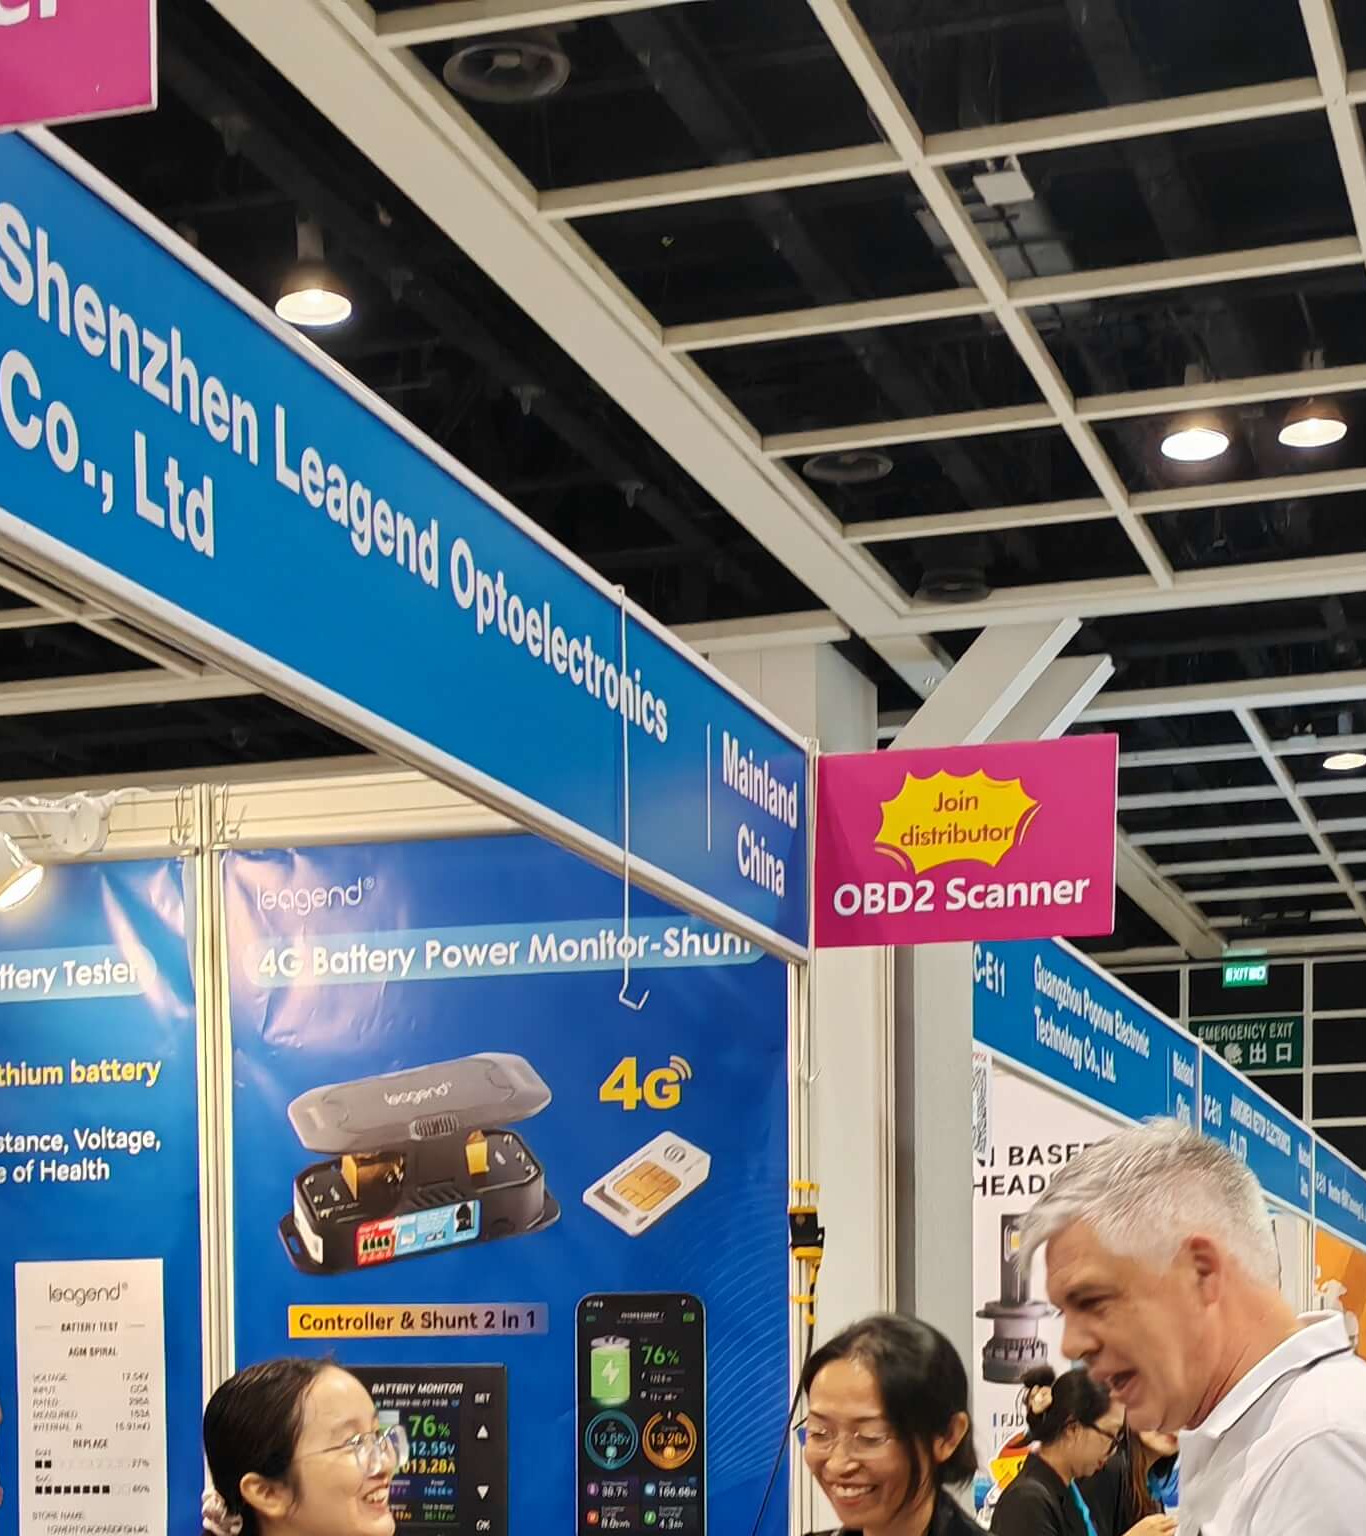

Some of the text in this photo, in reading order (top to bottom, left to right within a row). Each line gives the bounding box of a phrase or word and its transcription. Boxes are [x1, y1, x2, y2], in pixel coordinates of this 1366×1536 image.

[134, 431, 215, 558] Ltd
[275, 406, 439, 588] Leagend
[451, 538, 669, 744] Optoelectronics
[722, 731, 798, 829] Mainland
[934, 790, 979, 813] Join
[900, 823, 1013, 847] distributor
[737, 825, 785, 897] China
[833, 876, 1090, 917] OBD2 Scanner
[258, 950, 303, 980] 4G
[312, 943, 412, 979] Battery
[424, 936, 519, 972] Power
[972, 943, 1006, 998] C-E11
[63, 959, 138, 986] Tester
[1034, 954, 1083, 1019] Guangzhou
[1225, 967, 1248, 983] EXIT
[1034, 1004, 1084, 1072] Technology
[1197, 1021, 1294, 1042] EMERGENCY EXIT
[1210, 1040, 1293, 1066] 急出口
[70, 1058, 162, 1087] battery
[598, 1055, 683, 1112] 4G
[73, 1126, 162, 1155] Voltage,
[1008, 1143, 1096, 1167] BASE
[12, 1158, 35, 1183] of
[40, 1156, 110, 1182] Health
[299, 1311, 397, 1332] Controller
[401, 1312, 415, 1330] &
[420, 1310, 479, 1330] Shunt
[484, 1311, 498, 1329] 2
[526, 1309, 536, 1328] 1
[641, 1344, 680, 1366] 76%
[371, 1382, 464, 1395] BATTERY MONITOR
[408, 1414, 451, 1438] 76%
